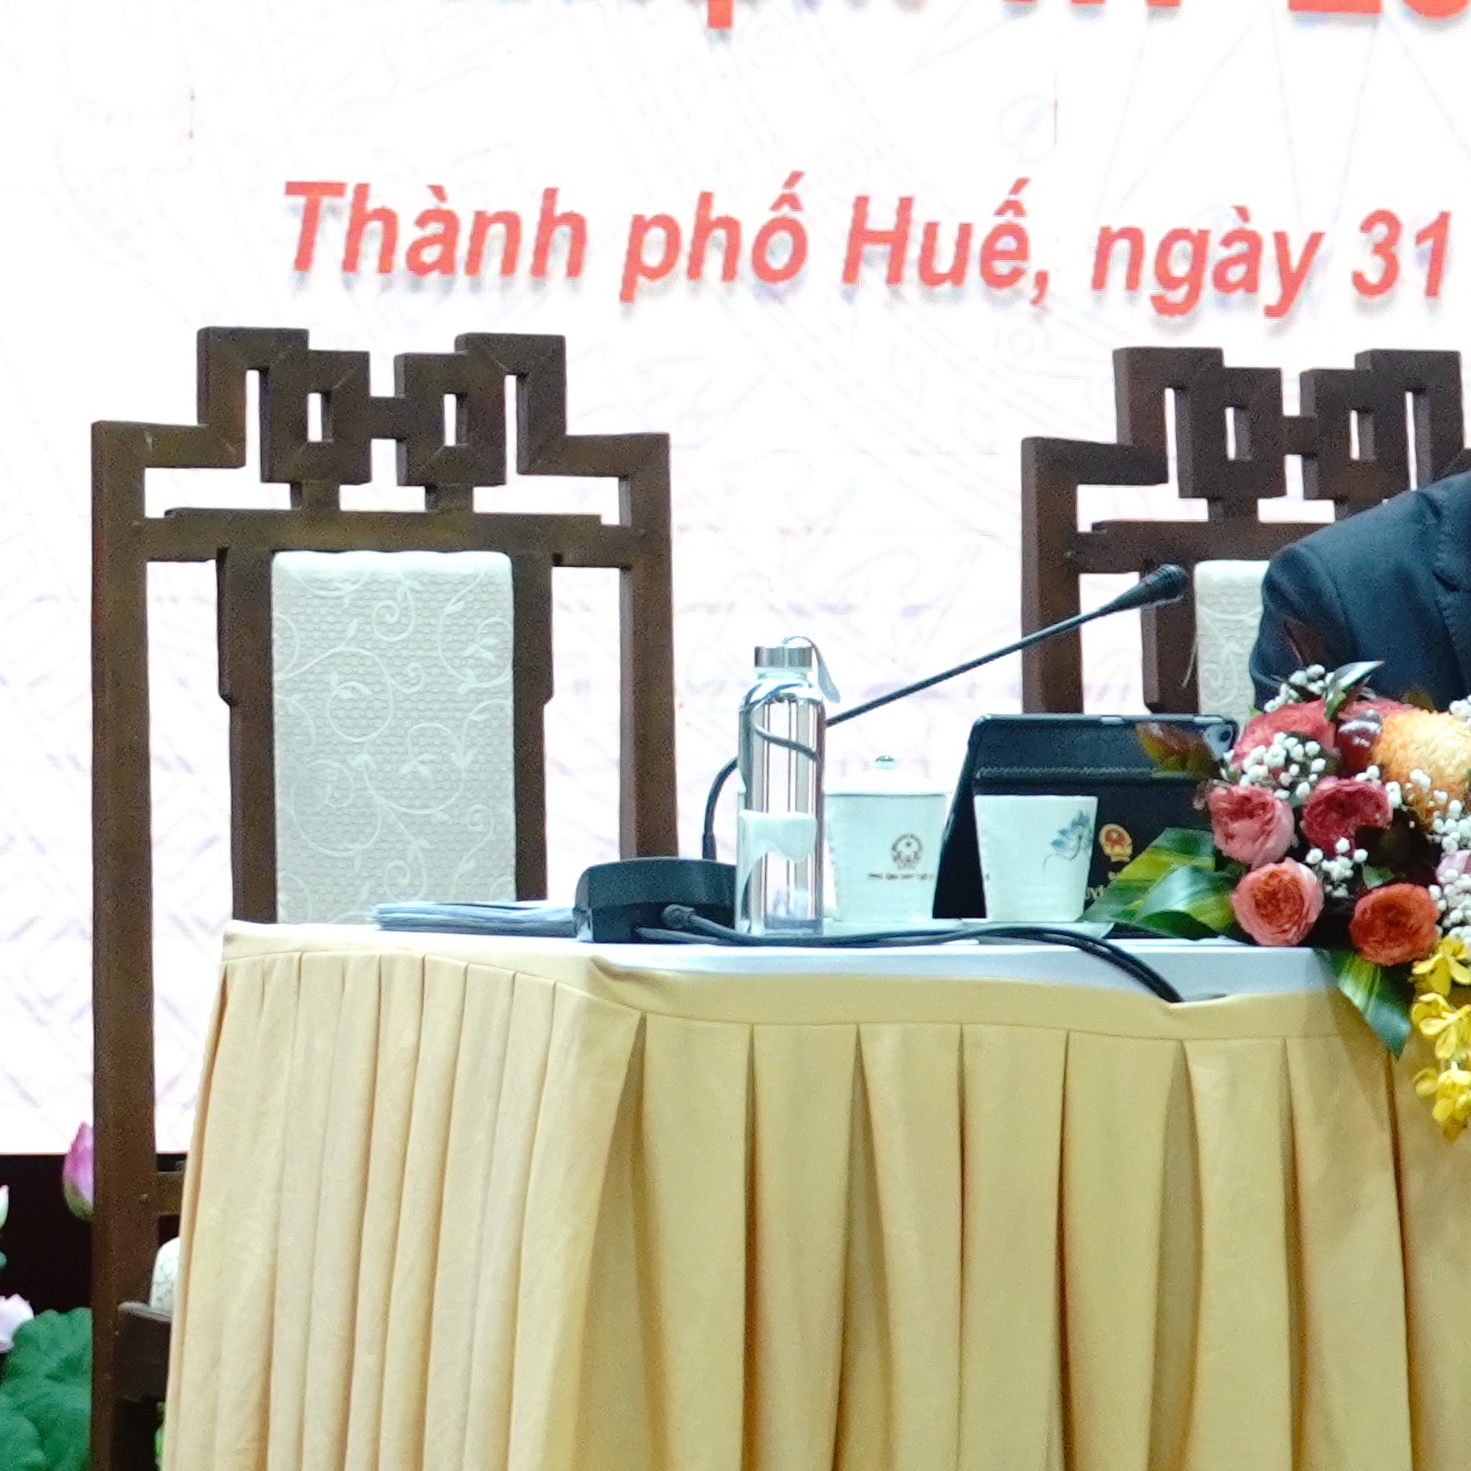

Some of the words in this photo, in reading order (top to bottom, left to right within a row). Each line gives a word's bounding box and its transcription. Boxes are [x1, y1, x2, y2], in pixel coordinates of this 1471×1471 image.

[284, 180, 587, 278] Thành
[620, 170, 808, 303] phố
[843, 176, 1049, 305] Huế,
[1091, 208, 1324, 319] ngày
[1351, 209, 1451, 298] 31
